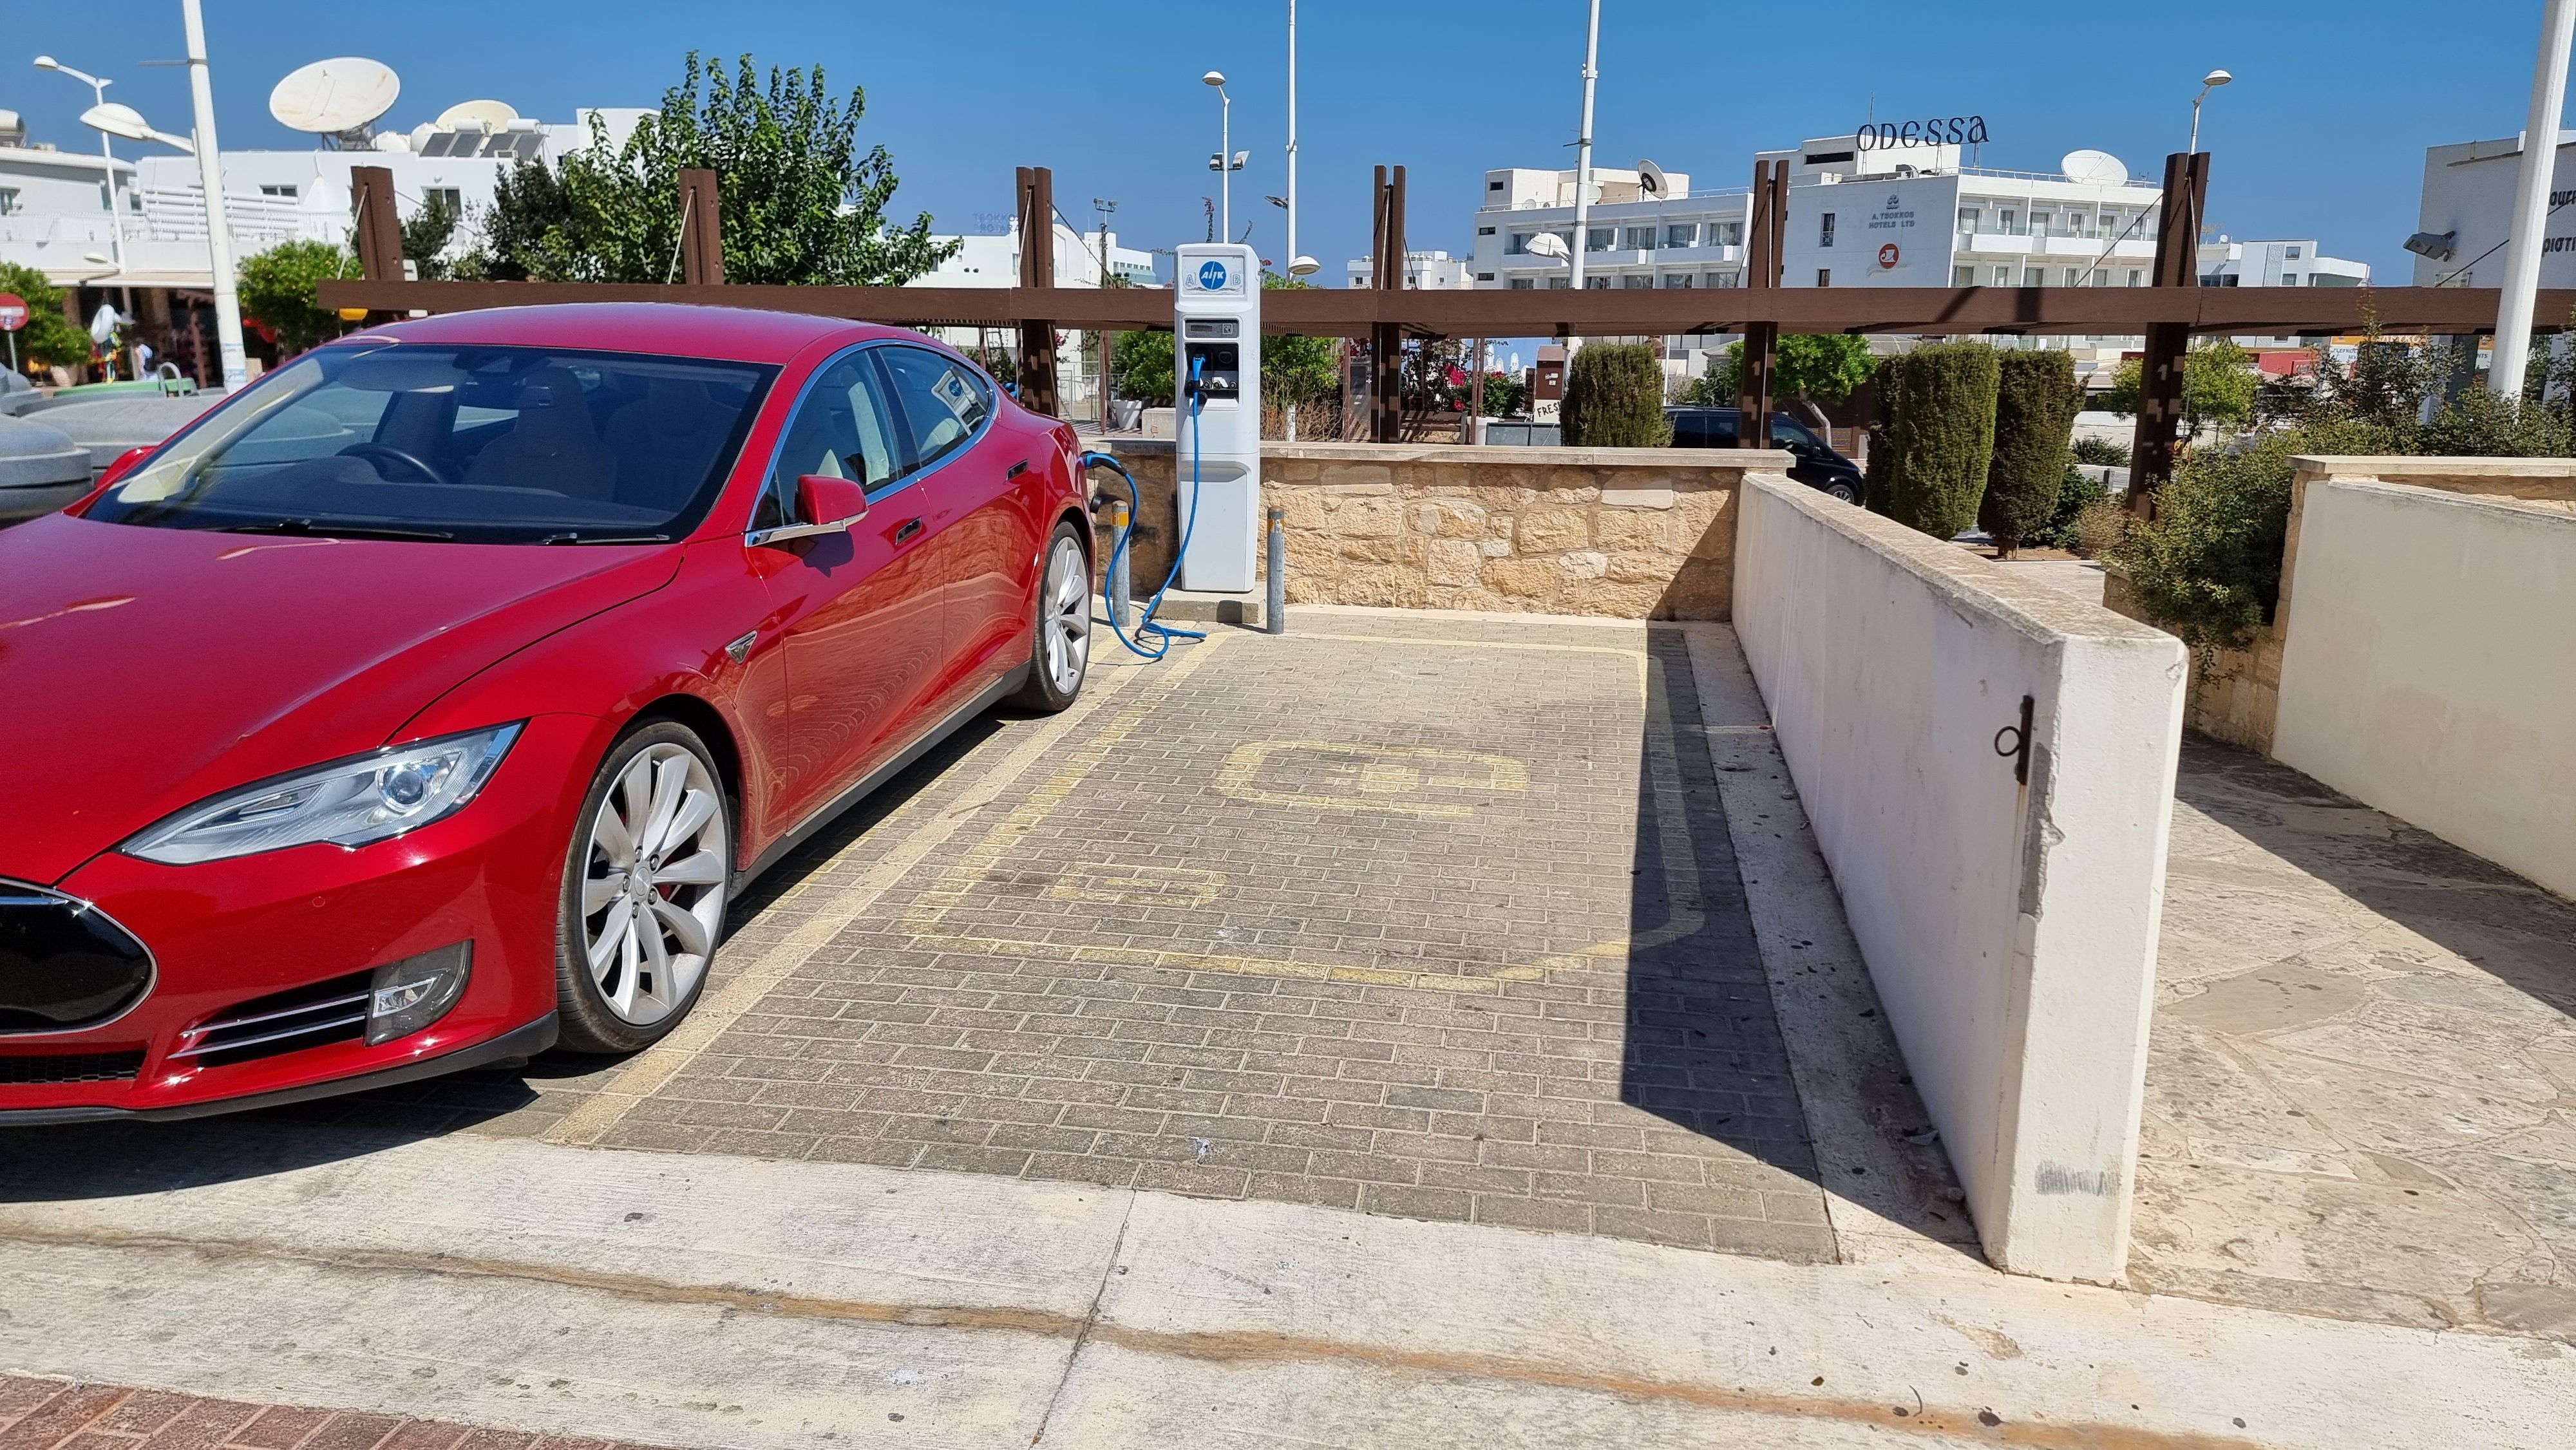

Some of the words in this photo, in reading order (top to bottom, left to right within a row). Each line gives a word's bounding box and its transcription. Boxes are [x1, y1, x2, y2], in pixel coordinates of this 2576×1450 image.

[1880, 211, 1915, 220] TSOKKOS
[1185, 274, 1195, 285] A
[1232, 274, 1242, 285] B
